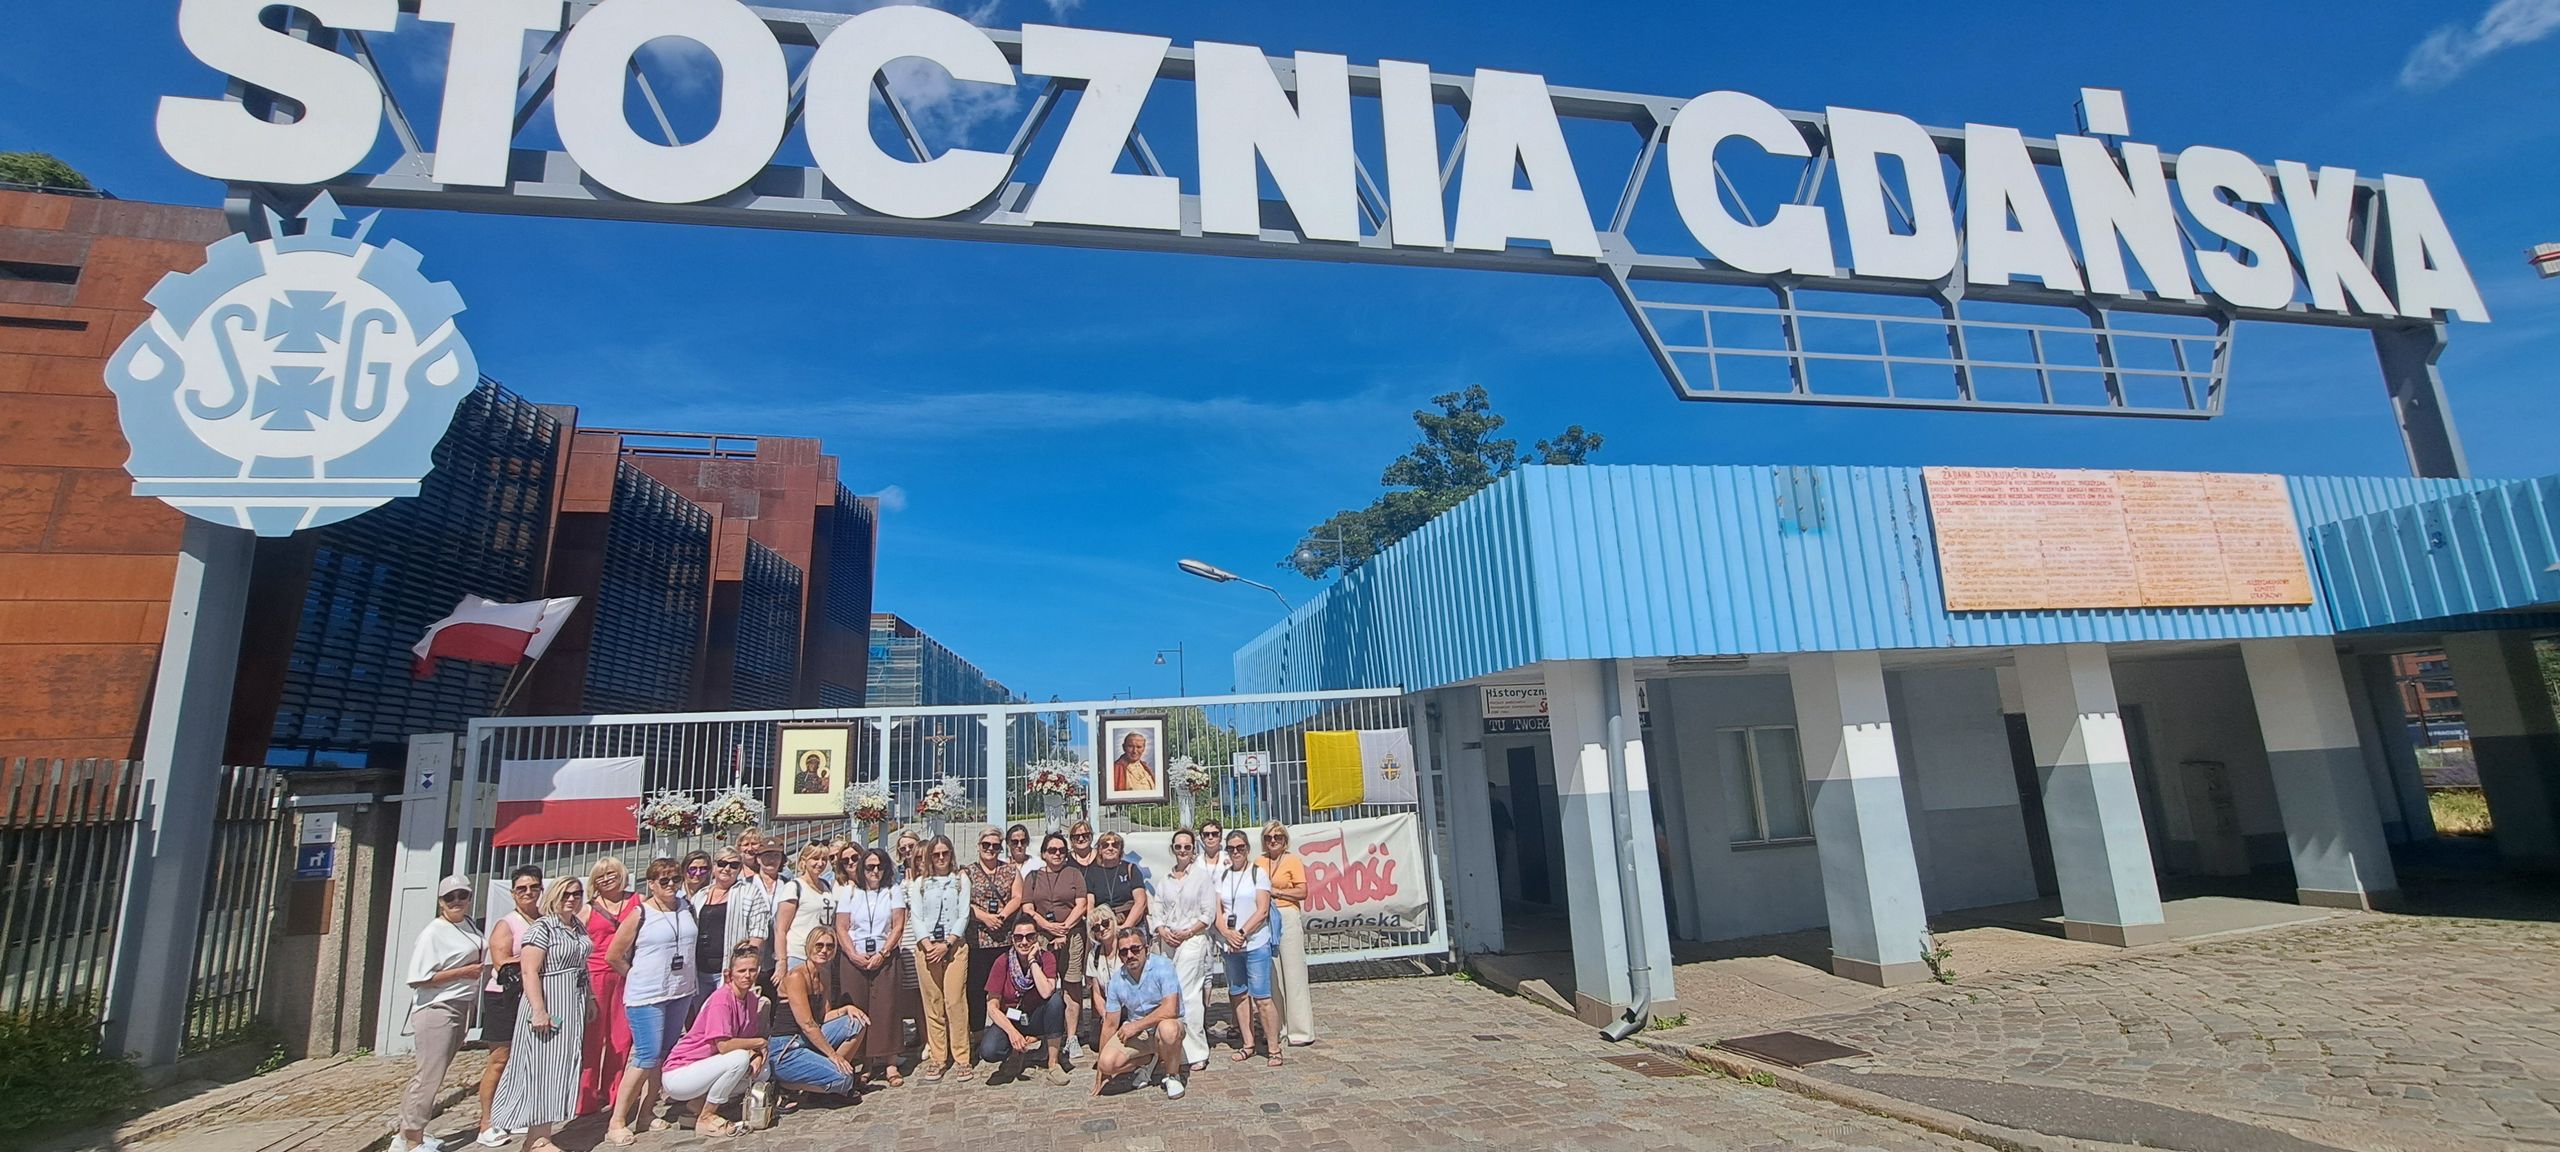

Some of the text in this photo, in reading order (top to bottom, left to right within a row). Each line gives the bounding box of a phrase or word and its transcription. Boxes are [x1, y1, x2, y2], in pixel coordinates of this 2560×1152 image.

[156, 0, 2491, 323] STOCZNIA GDAŃSKA
[1489, 719, 1505, 731] TU
[1306, 912, 1401, 931] Gdańska
